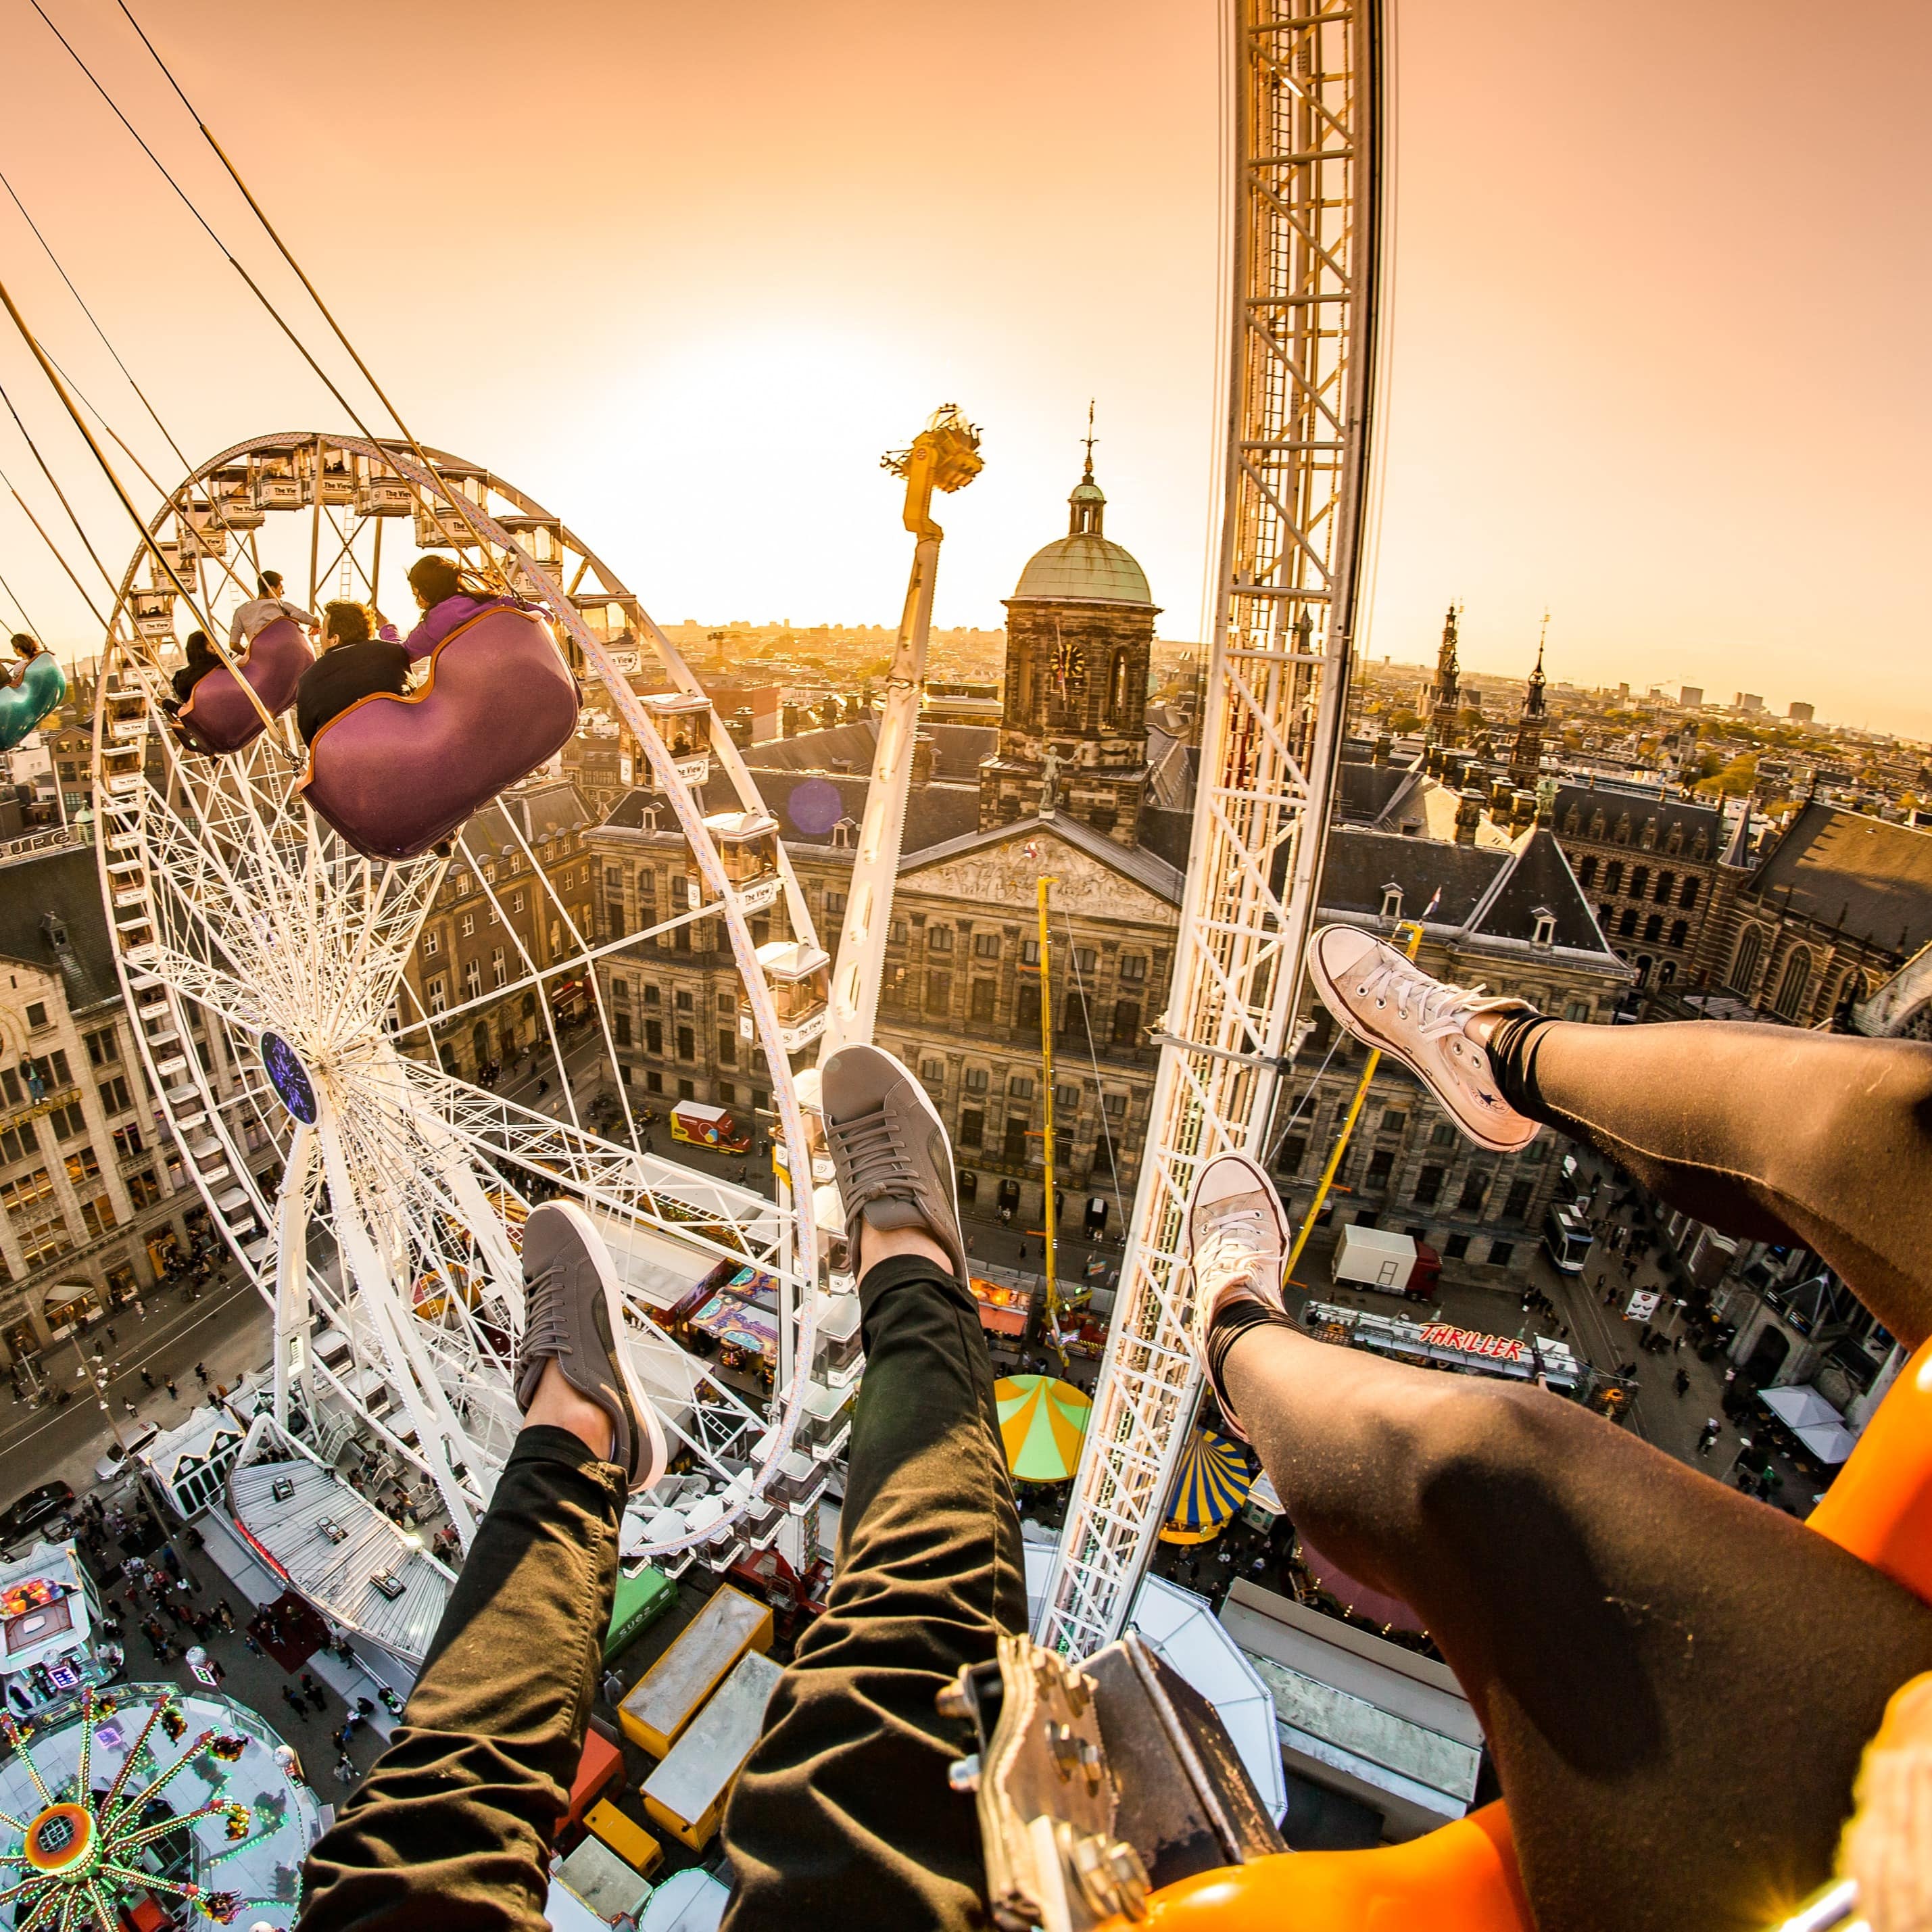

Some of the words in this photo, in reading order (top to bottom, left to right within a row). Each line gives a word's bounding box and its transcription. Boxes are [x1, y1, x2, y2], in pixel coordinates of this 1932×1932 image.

[0, 831, 70, 859] URG
[744, 893, 755, 903] The
[756, 888, 770, 898] View
[1419, 1323, 1525, 1361] THRILLER
